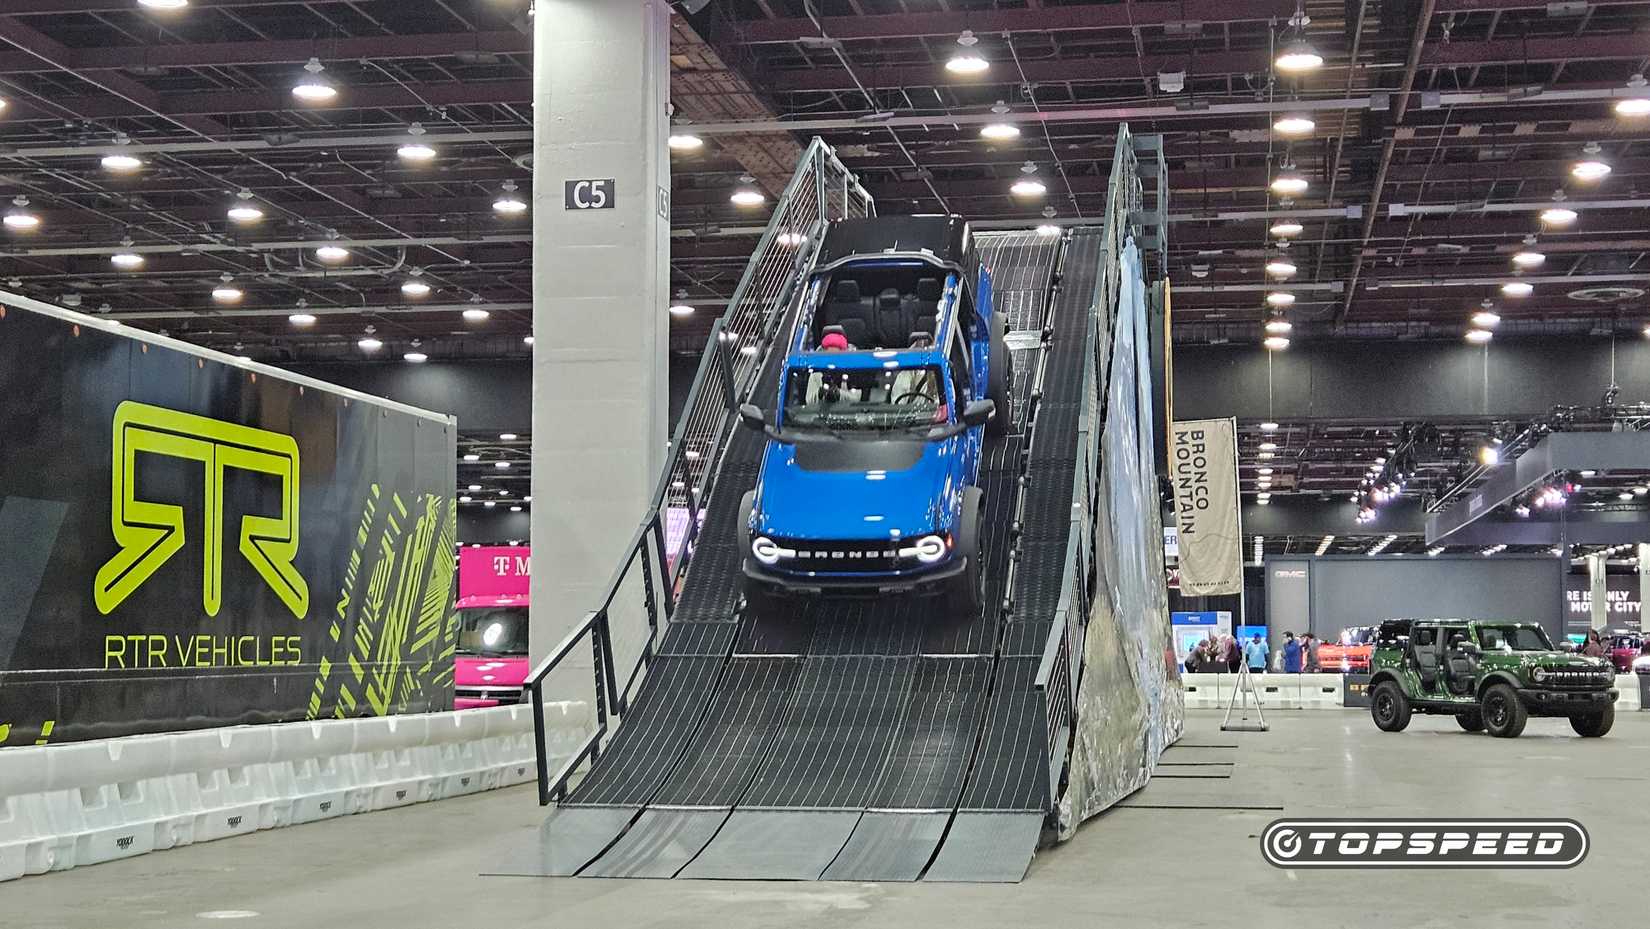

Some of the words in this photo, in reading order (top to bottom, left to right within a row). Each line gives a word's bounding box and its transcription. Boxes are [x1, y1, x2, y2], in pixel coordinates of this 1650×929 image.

[573, 180, 606, 209] C5
[1175, 431, 1195, 534] MOUNTAIN
[1190, 429, 1209, 510] BRONCO
[1614, 601, 1641, 612] CITY
[105, 635, 167, 669] RTR
[175, 634, 301, 667] VEHICLES
